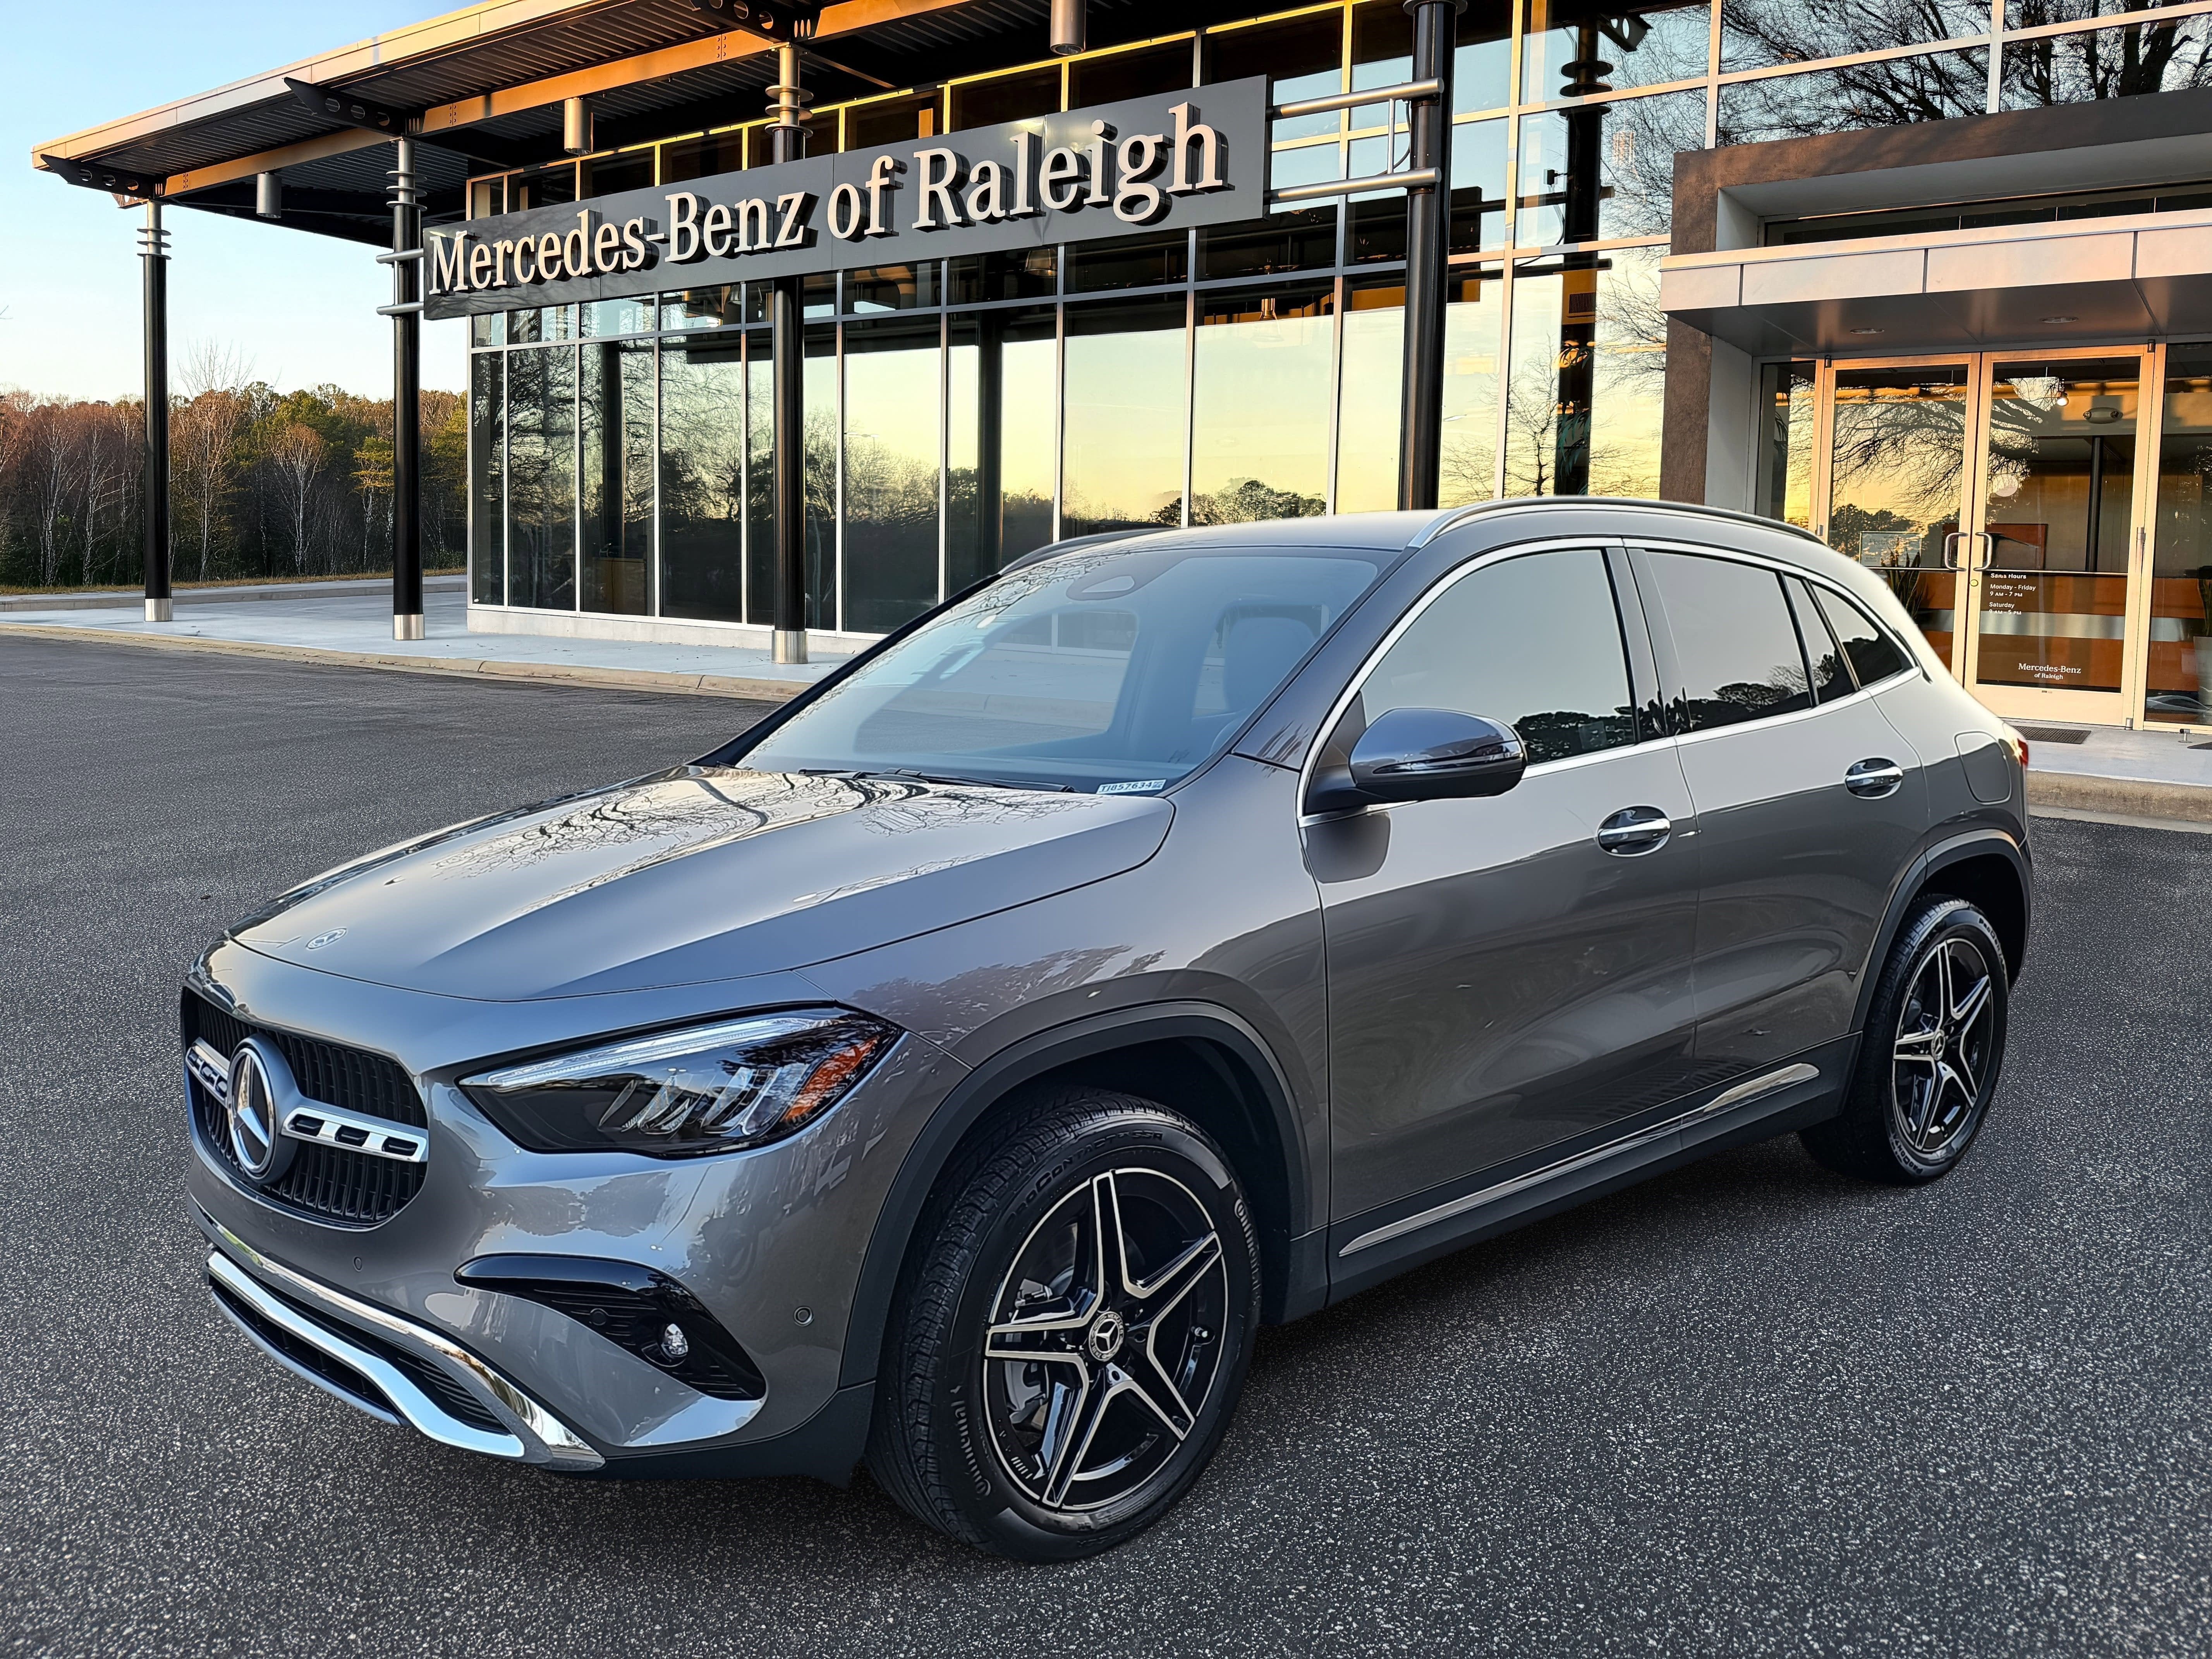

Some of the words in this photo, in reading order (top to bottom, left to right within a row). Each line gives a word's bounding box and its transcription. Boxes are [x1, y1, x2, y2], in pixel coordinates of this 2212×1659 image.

[428, 191, 806, 295] Mercedes-Benz
[827, 155, 894, 239] of
[911, 101, 1223, 229] Raleigh
[2018, 663, 2081, 674] Mercedes-Benz
